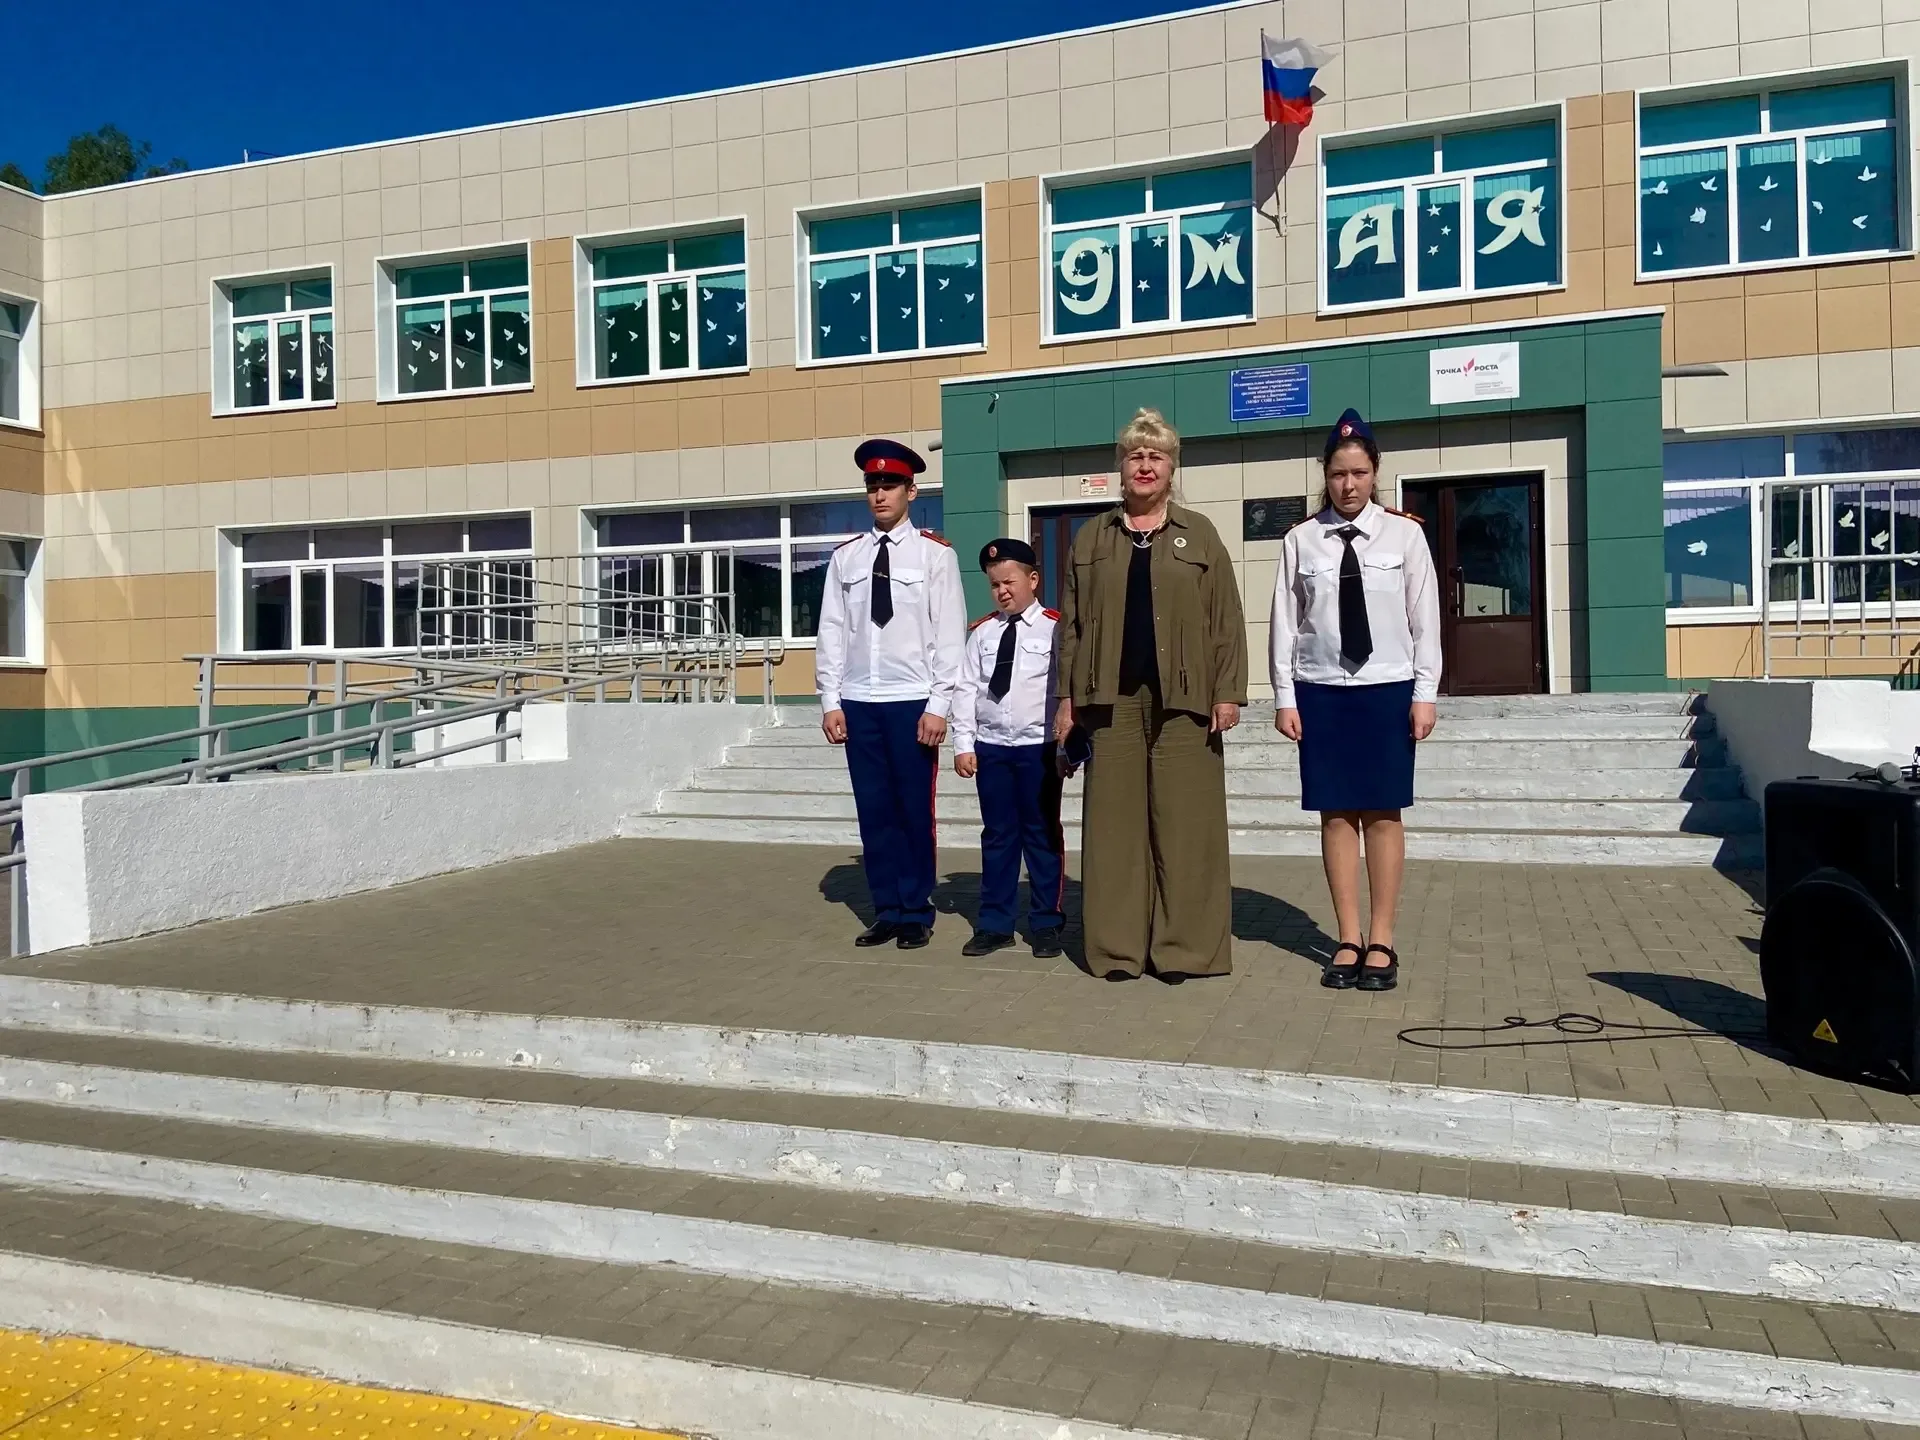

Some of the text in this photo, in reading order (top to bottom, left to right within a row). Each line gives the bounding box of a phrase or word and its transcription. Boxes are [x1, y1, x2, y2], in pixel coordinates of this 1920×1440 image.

[1059, 237, 1114, 315] 9
[1436, 364, 1499, 375] ТОЧКА РОСТА
